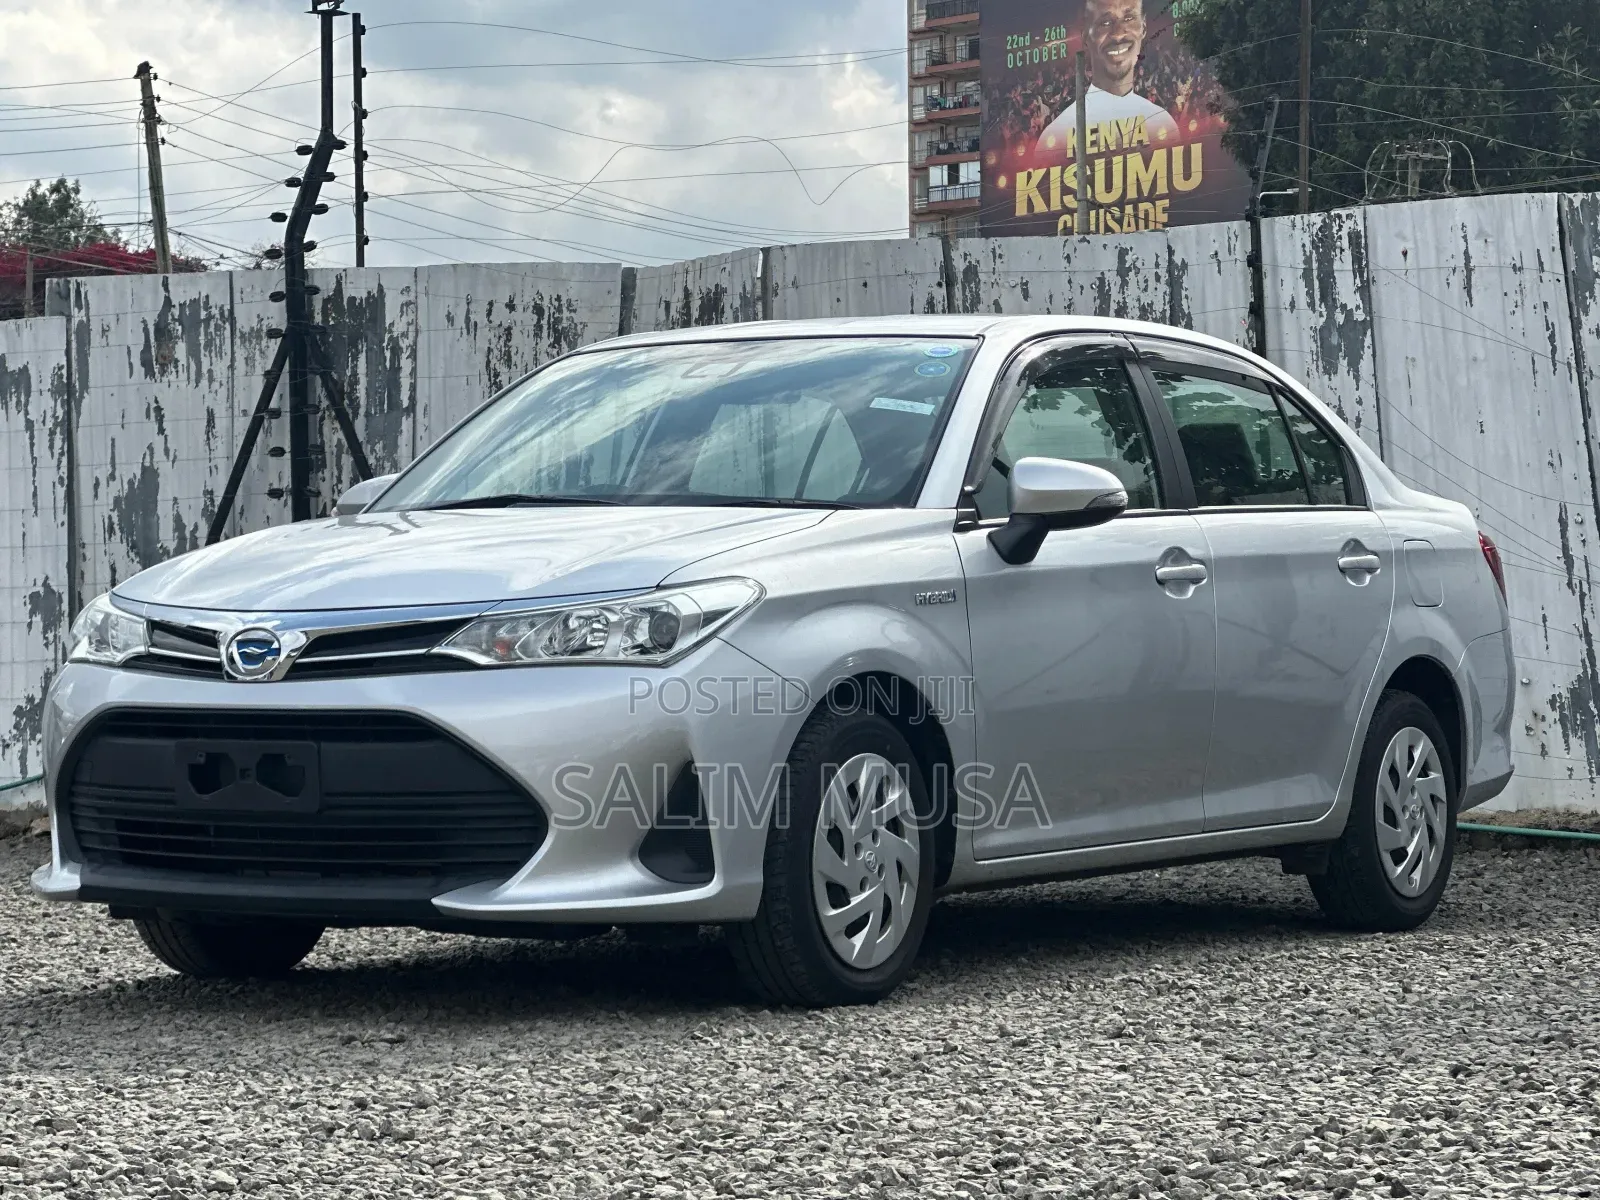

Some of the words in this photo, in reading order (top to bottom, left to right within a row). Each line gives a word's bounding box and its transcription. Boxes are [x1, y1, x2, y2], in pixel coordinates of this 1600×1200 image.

[1006, 31, 1031, 50] 22nd
[1044, 24, 1066, 42] 26th
[1007, 42, 1067, 69] OCTOBER
[1015, 143, 1202, 217] KISUMU
[1057, 199, 1169, 236] CUSADE
